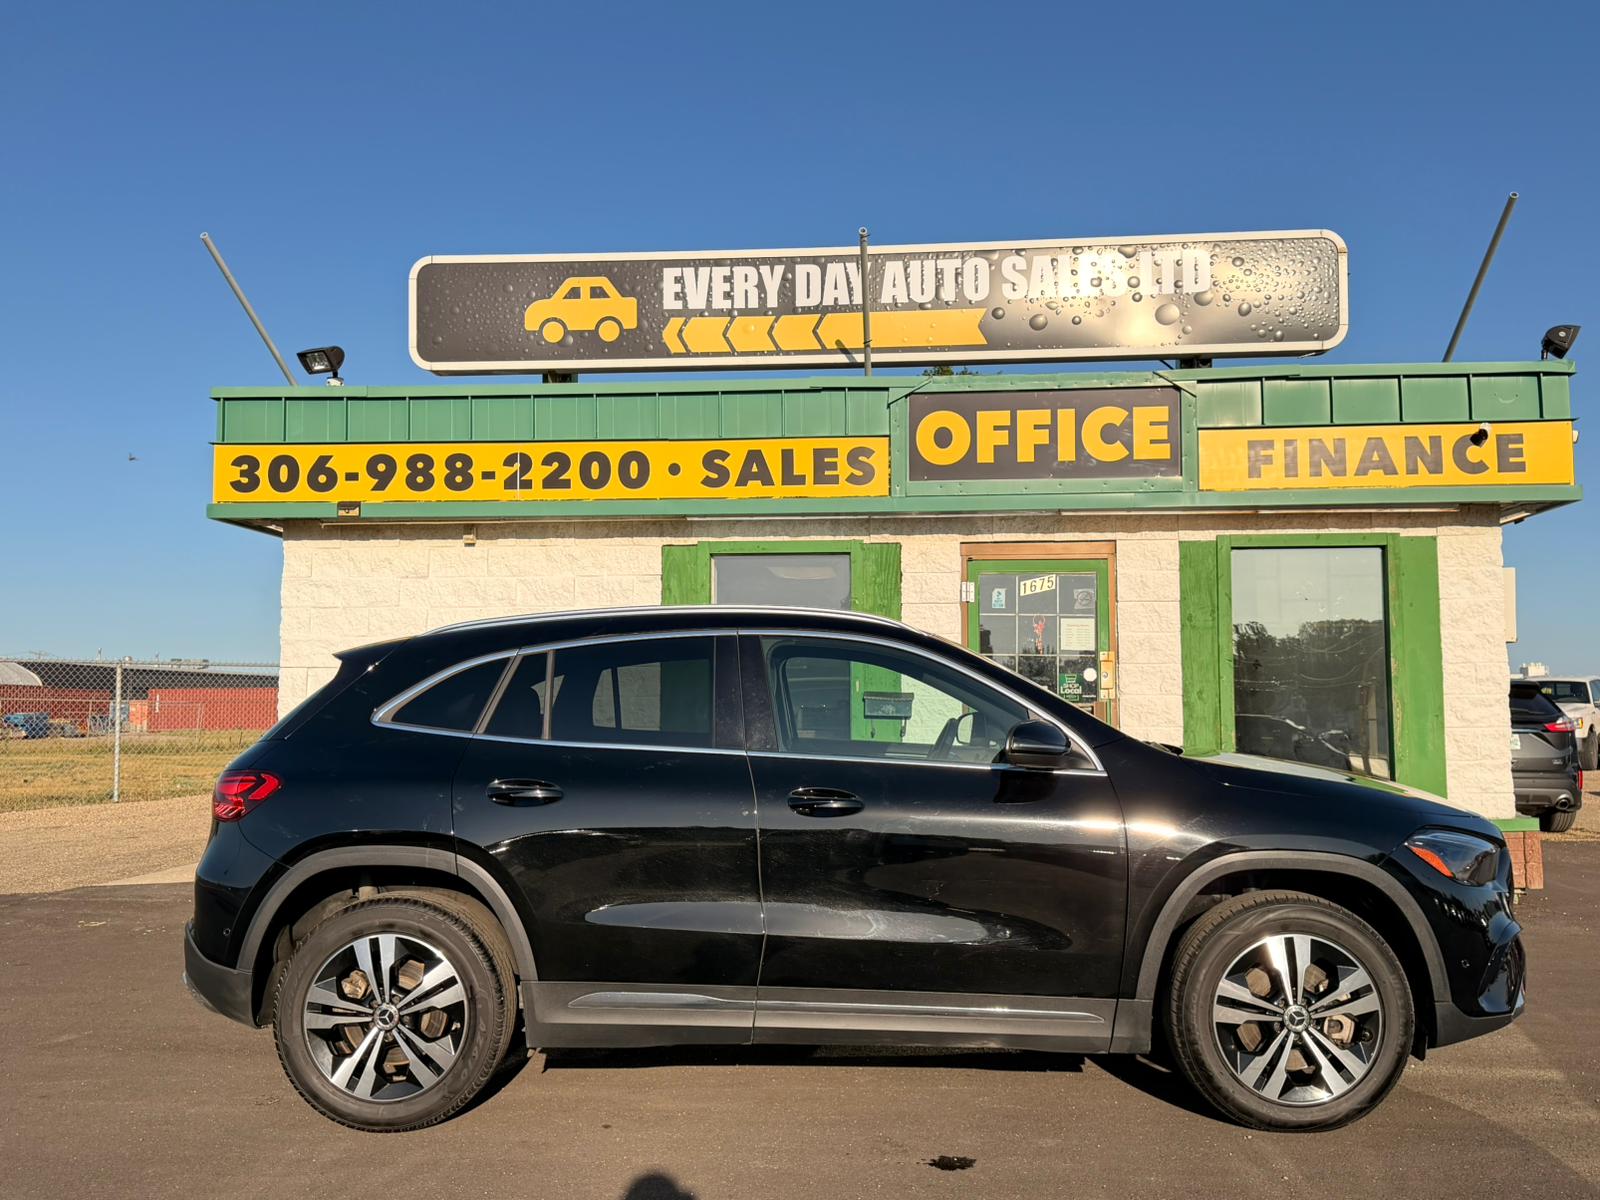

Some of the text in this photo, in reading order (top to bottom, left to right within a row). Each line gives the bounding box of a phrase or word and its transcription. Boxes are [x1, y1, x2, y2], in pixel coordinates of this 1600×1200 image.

[663, 249, 1211, 310] EVERY DAY AUTO SALES LTD
[915, 405, 1171, 466] OFFICE
[1247, 433, 1526, 478] FINANCE
[229, 447, 876, 492] 306-988-2200 SALES
[1023, 576, 1054, 594] 1675
[1060, 686, 1082, 694] Local
